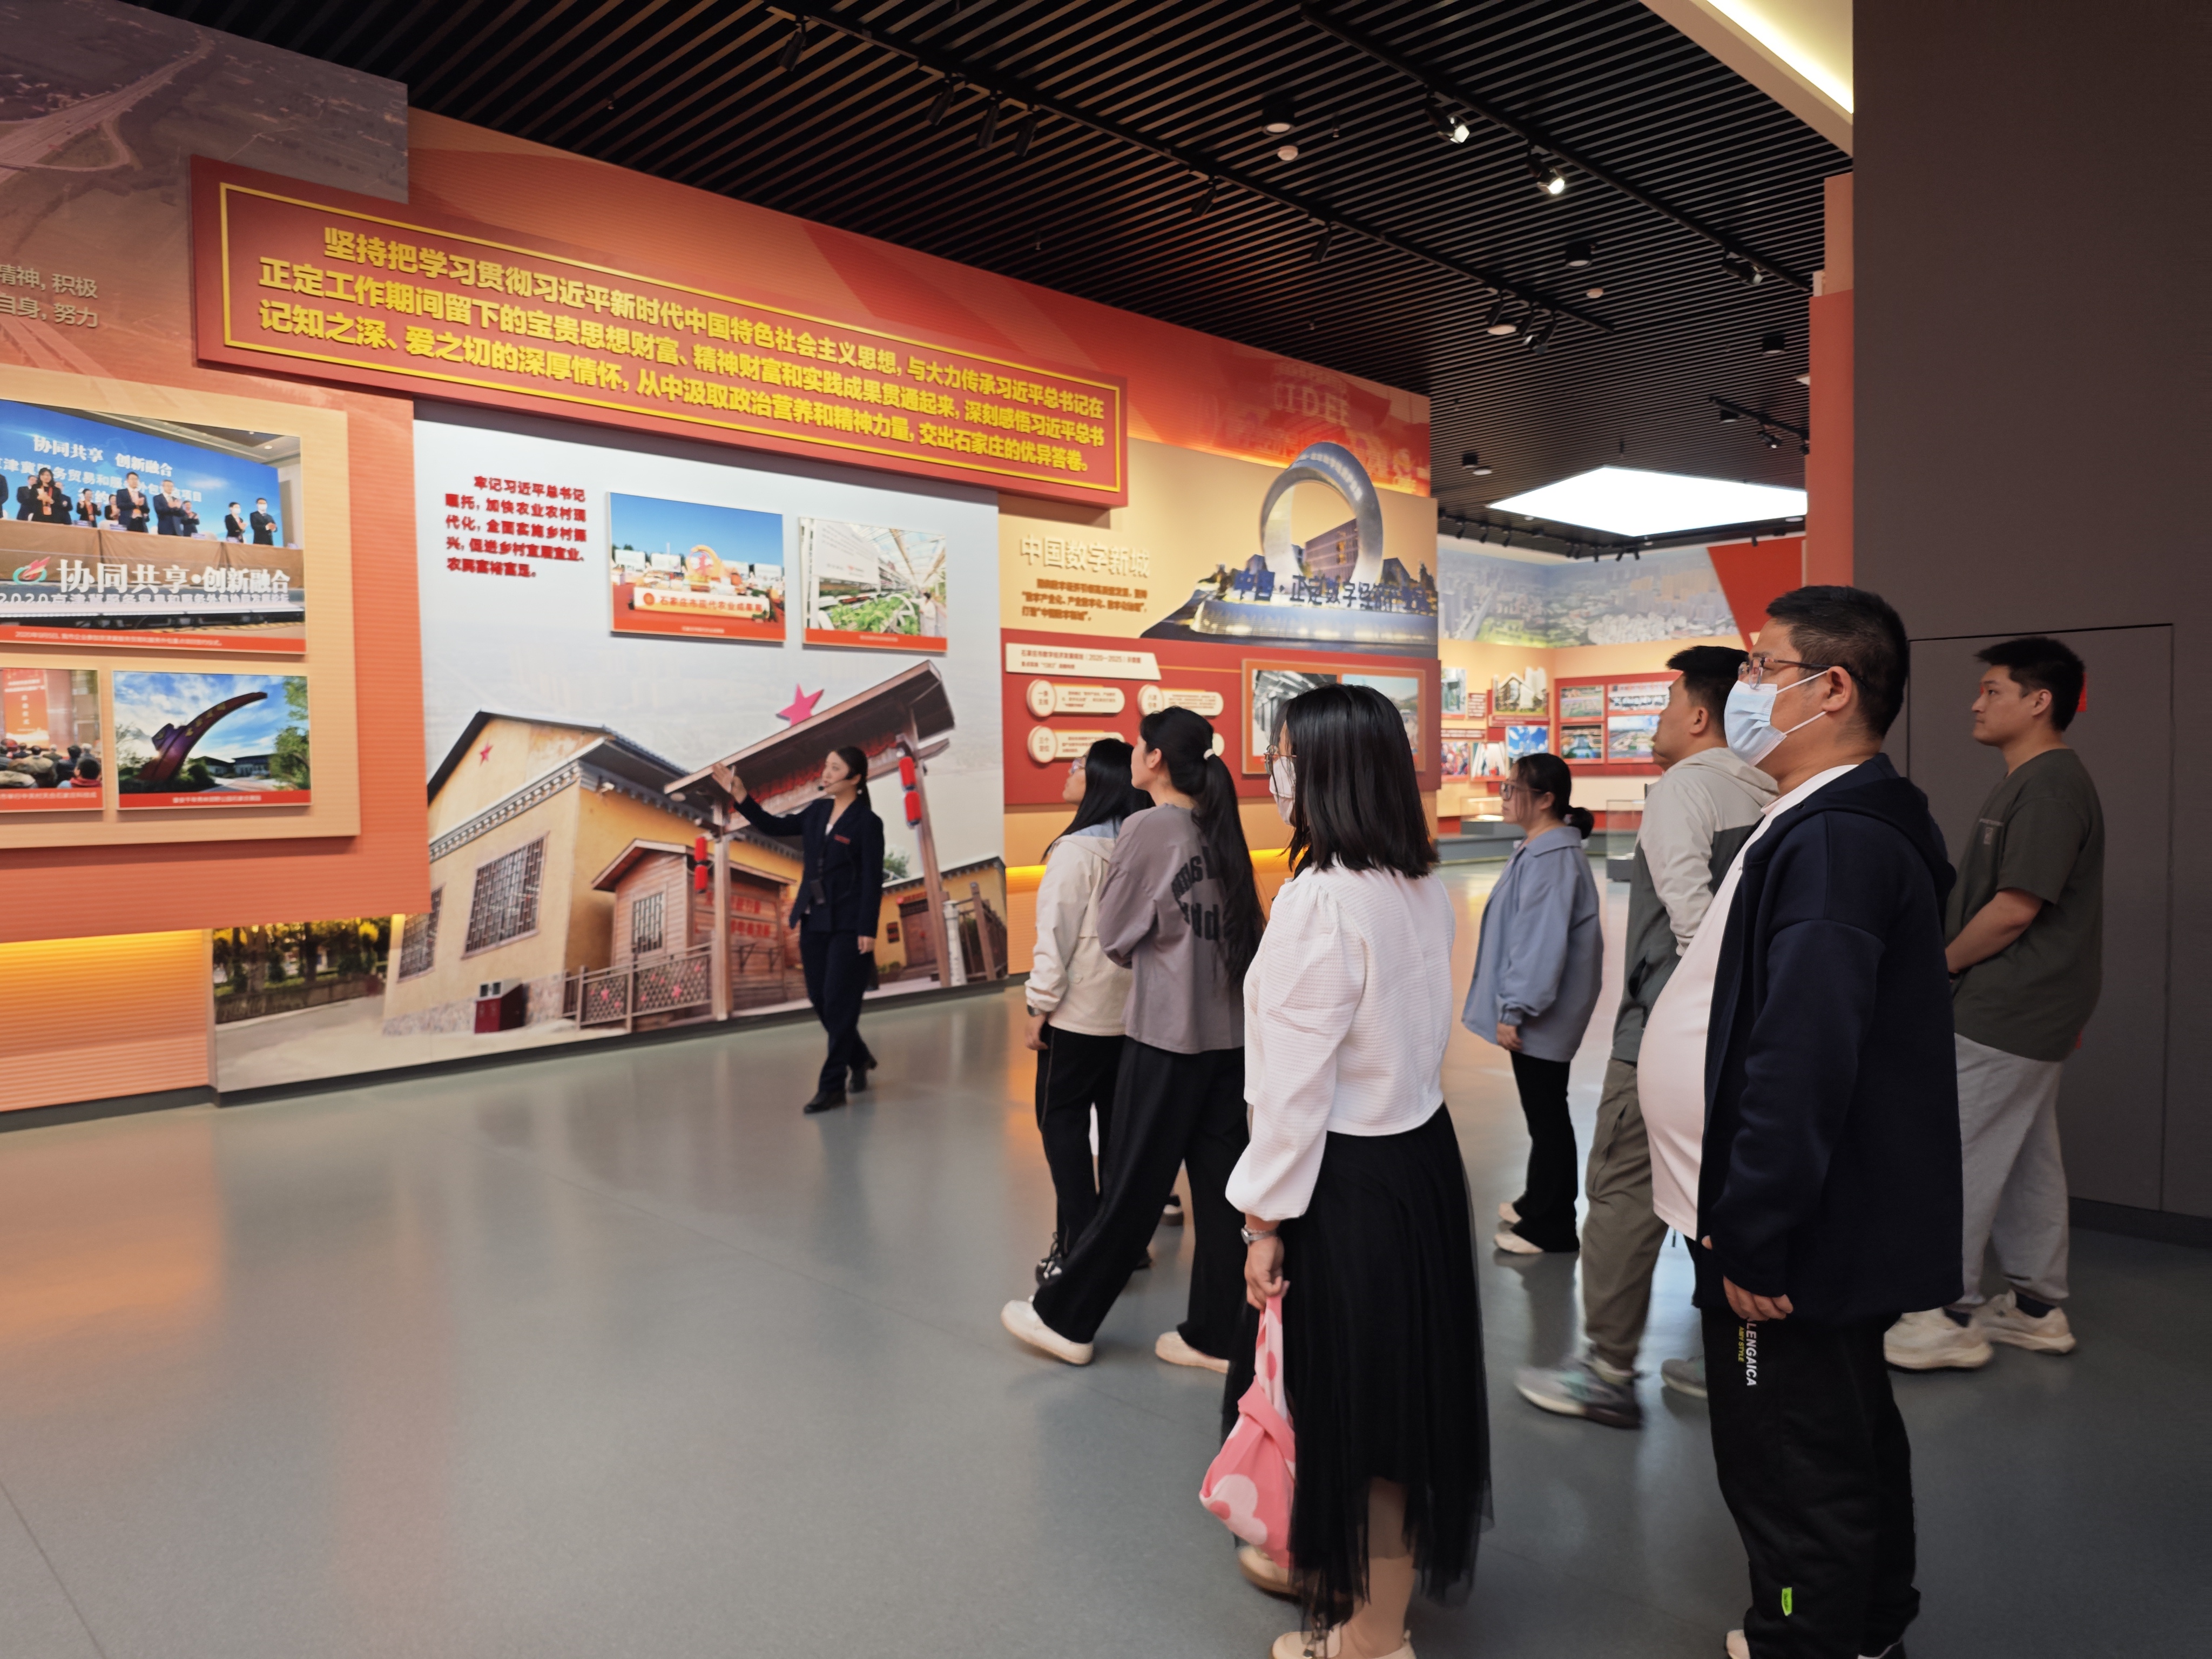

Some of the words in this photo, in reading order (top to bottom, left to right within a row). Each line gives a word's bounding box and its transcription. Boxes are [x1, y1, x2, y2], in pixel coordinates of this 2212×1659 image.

[33, 434, 103, 463] 协同共享
[115, 452, 173, 477] 创新融合
[474, 476, 585, 502] 牢记习近平总书记
[1020, 533, 1150, 579] 中国数字新城
[1746, 1319, 1757, 1386] LENGAICA
